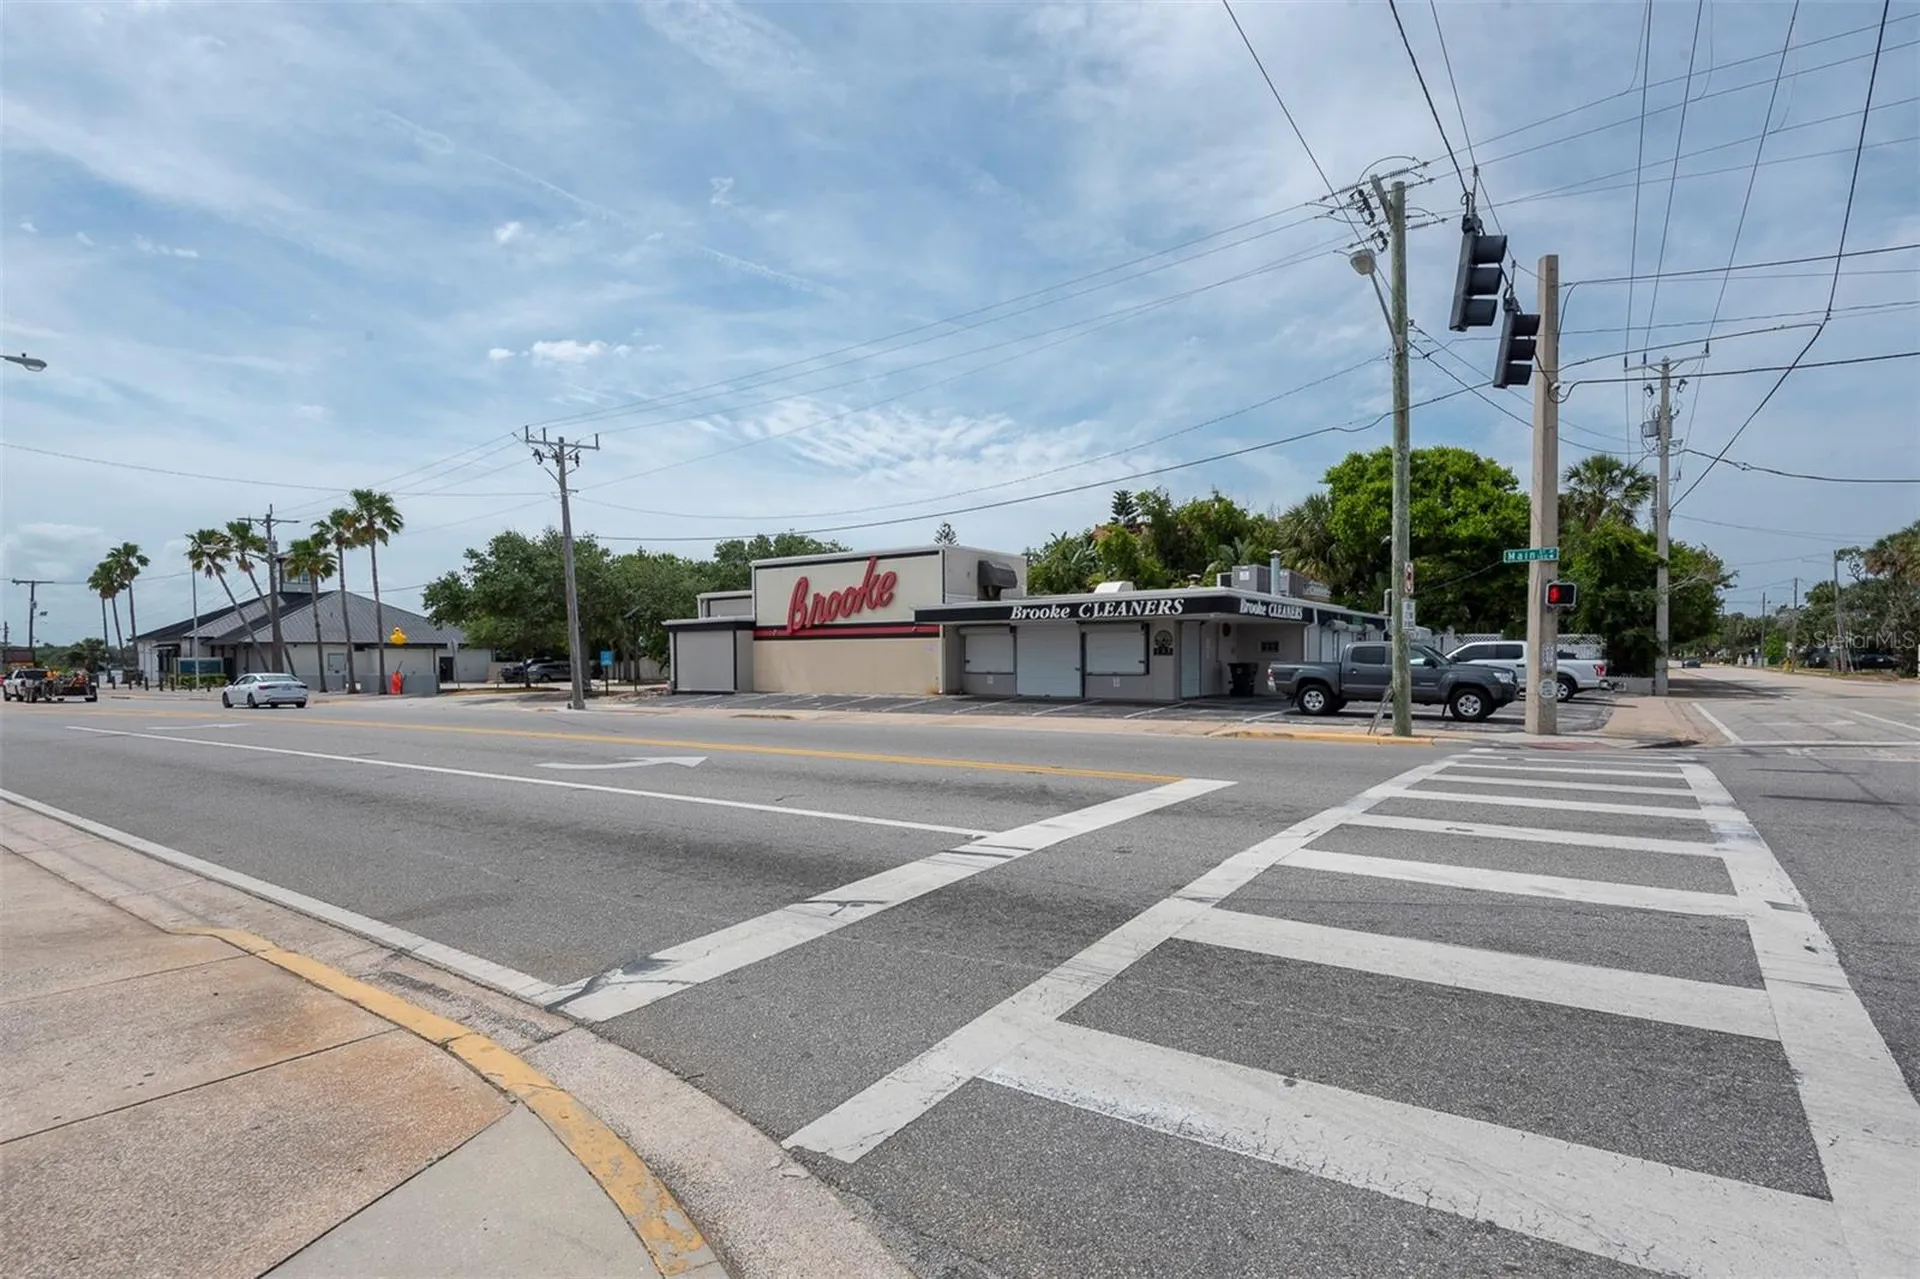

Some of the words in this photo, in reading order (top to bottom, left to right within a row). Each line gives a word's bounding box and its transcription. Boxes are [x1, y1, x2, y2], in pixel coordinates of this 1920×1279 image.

[1507, 552, 1537, 561] Main
[786, 555, 897, 635] Brooke
[1010, 604, 1070, 620] Brooke
[1078, 599, 1184, 618] CLEANERS
[1239, 597, 1267, 616] Brooke
[1268, 603, 1304, 620] CLEANERS
